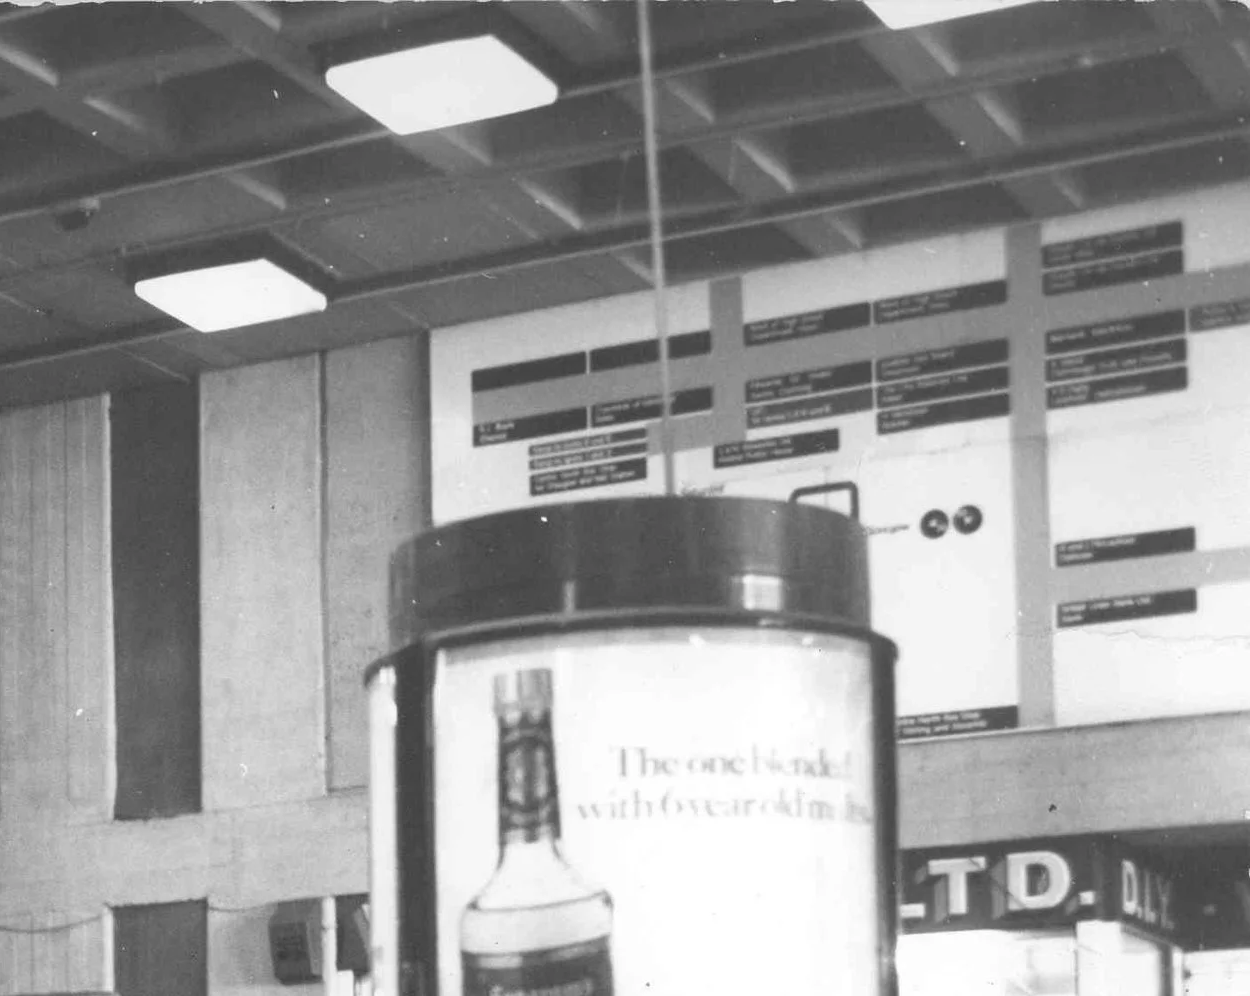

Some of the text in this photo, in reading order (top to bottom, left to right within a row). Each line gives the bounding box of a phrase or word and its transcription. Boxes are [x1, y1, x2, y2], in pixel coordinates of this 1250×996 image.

[608, 745, 679, 779] The
[684, 751, 745, 779] one
[577, 786, 653, 821] with
